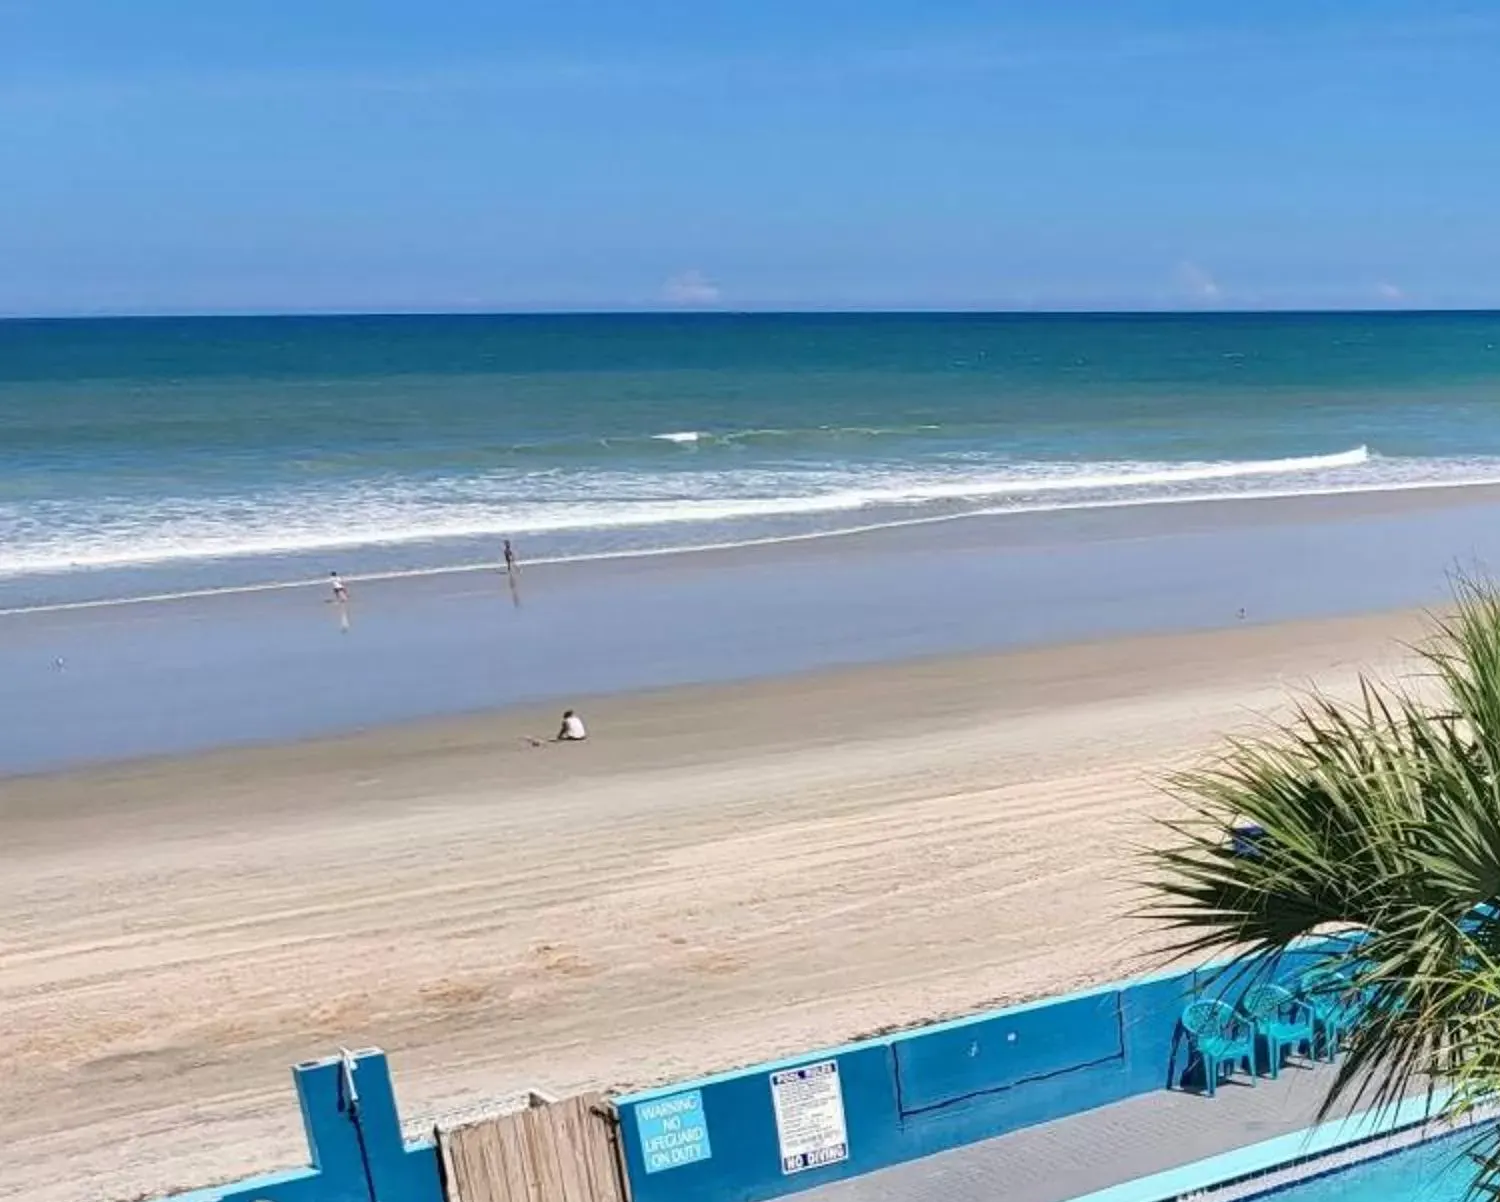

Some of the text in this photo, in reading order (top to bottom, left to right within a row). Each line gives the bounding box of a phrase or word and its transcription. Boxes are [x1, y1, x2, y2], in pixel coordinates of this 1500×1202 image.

[641, 1096, 697, 1120] WARNING
[663, 1115, 681, 1133] NO
[645, 1126, 703, 1152] LIFEGUARD
[652, 1145, 702, 1167] ON DUTY
[787, 1144, 844, 1170] NO DIVING
